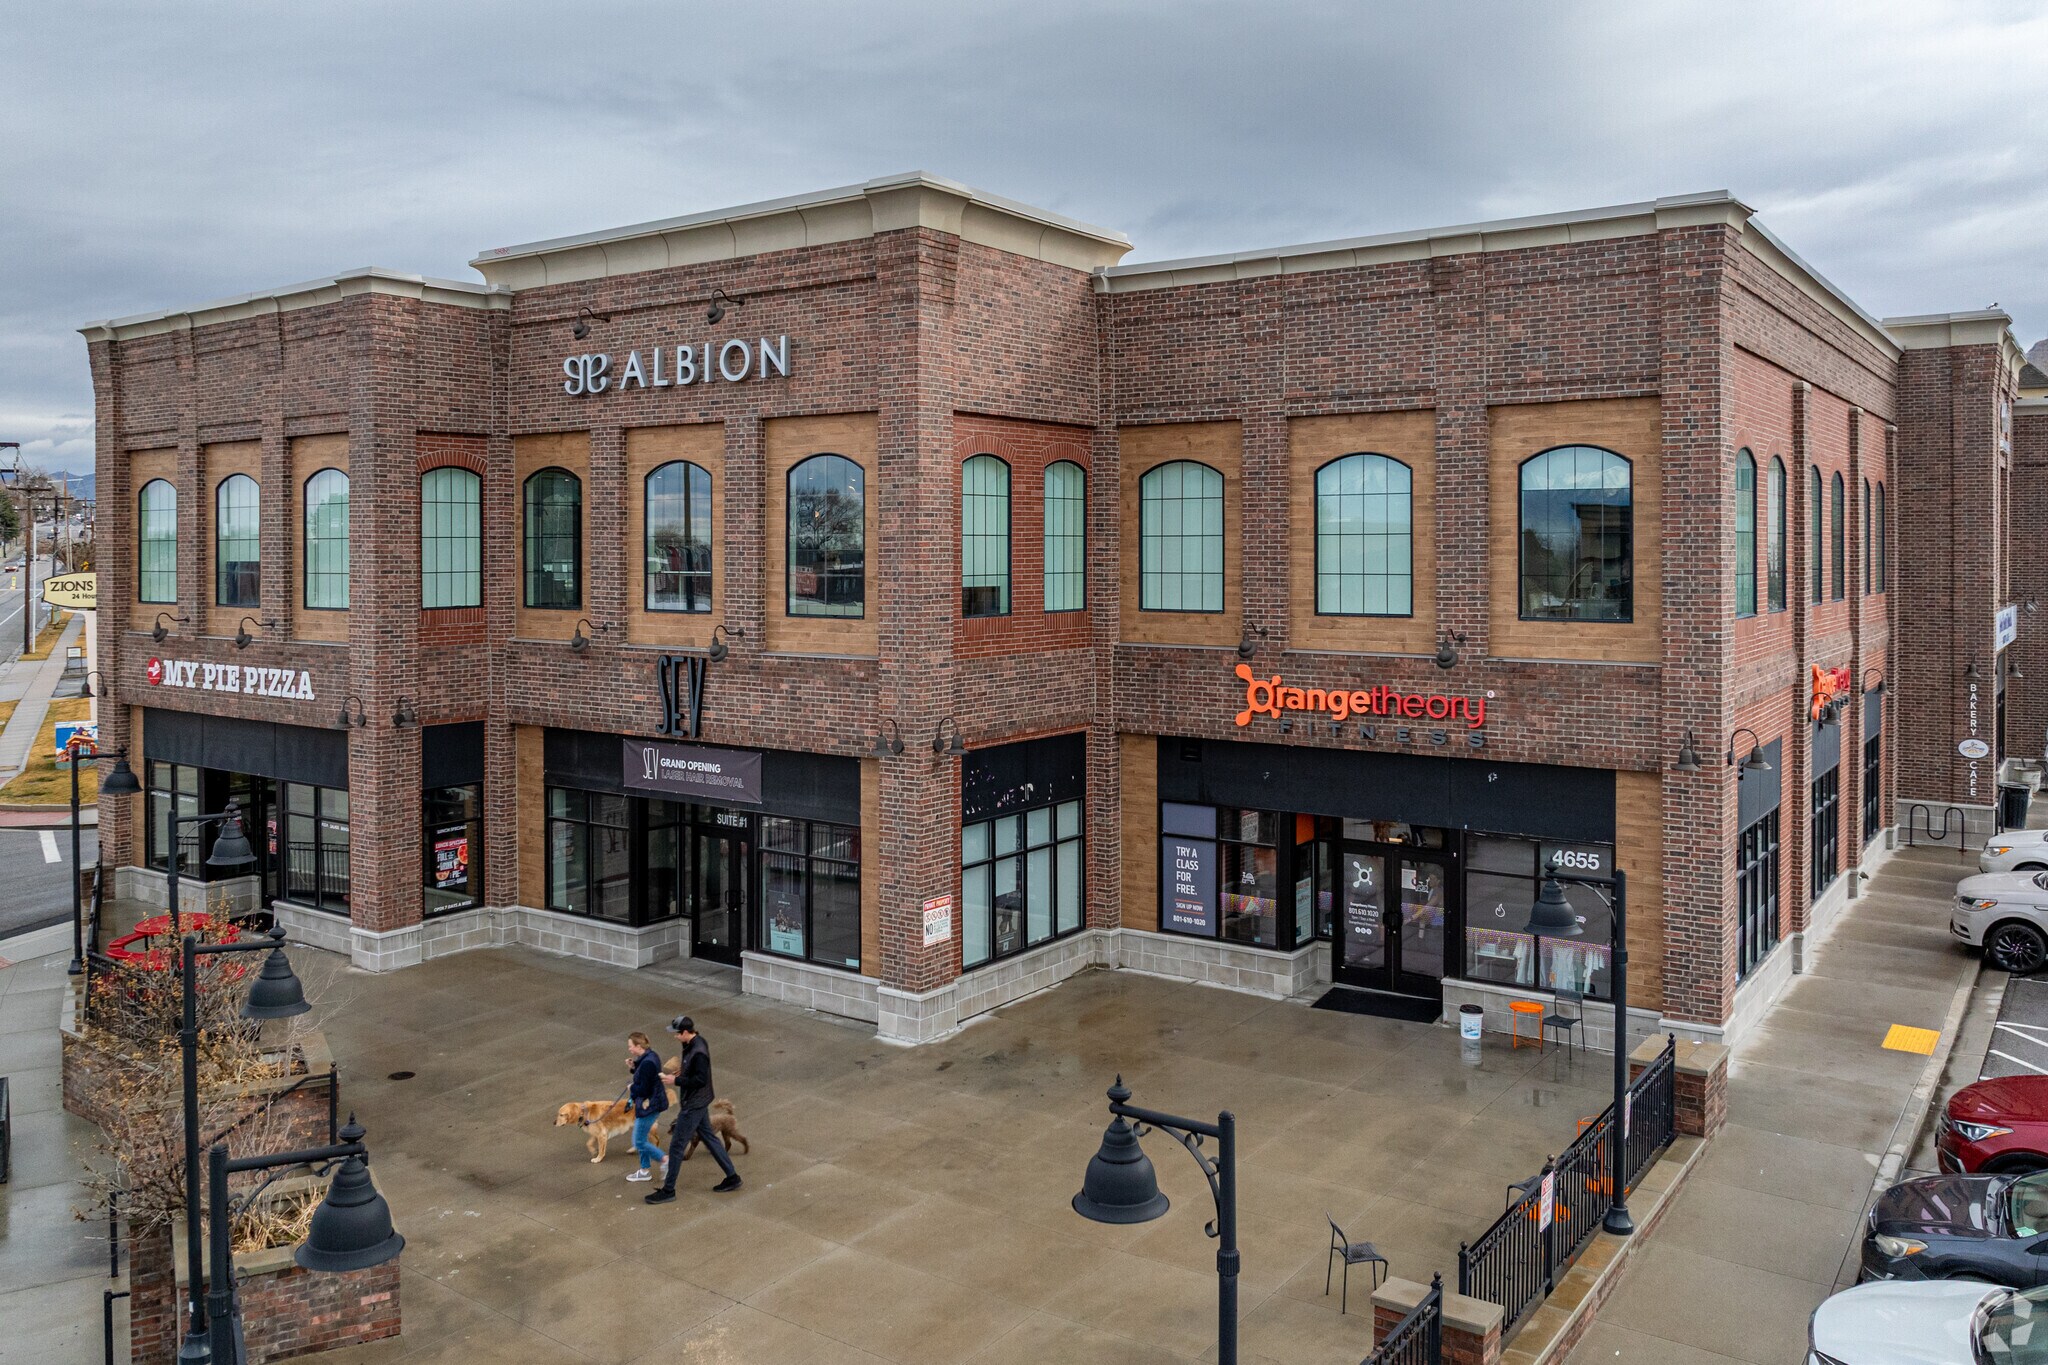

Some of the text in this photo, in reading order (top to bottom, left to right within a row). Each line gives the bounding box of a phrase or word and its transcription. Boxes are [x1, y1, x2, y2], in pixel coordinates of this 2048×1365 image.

[619, 335, 790, 390] ALBION
[50, 581, 94, 592] ZIONS
[164, 660, 315, 700] MY PIE PIZZA
[656, 655, 706, 738] SEV
[1969, 683, 1978, 736] BAKERY
[1280, 719, 1485, 748] FITNESS
[642, 747, 659, 780] SEV
[660, 758, 721, 774] GRAND OPENING
[661, 769, 744, 789] LASER HAIR REMOVAL
[1969, 760, 1978, 796] CAFE
[717, 813, 748, 828] SUITE #1
[1176, 846, 1198, 858] TRY A
[1552, 850, 1600, 870] 4655
[1176, 858, 1199, 871] CLASS
[1176, 871, 1192, 882] FOR
[1176, 884, 1198, 896] FREE.
[1175, 902, 1186, 910] SIGN
[1173, 915, 1206, 926] 801-610-1020
[925, 923, 934, 937] NO
